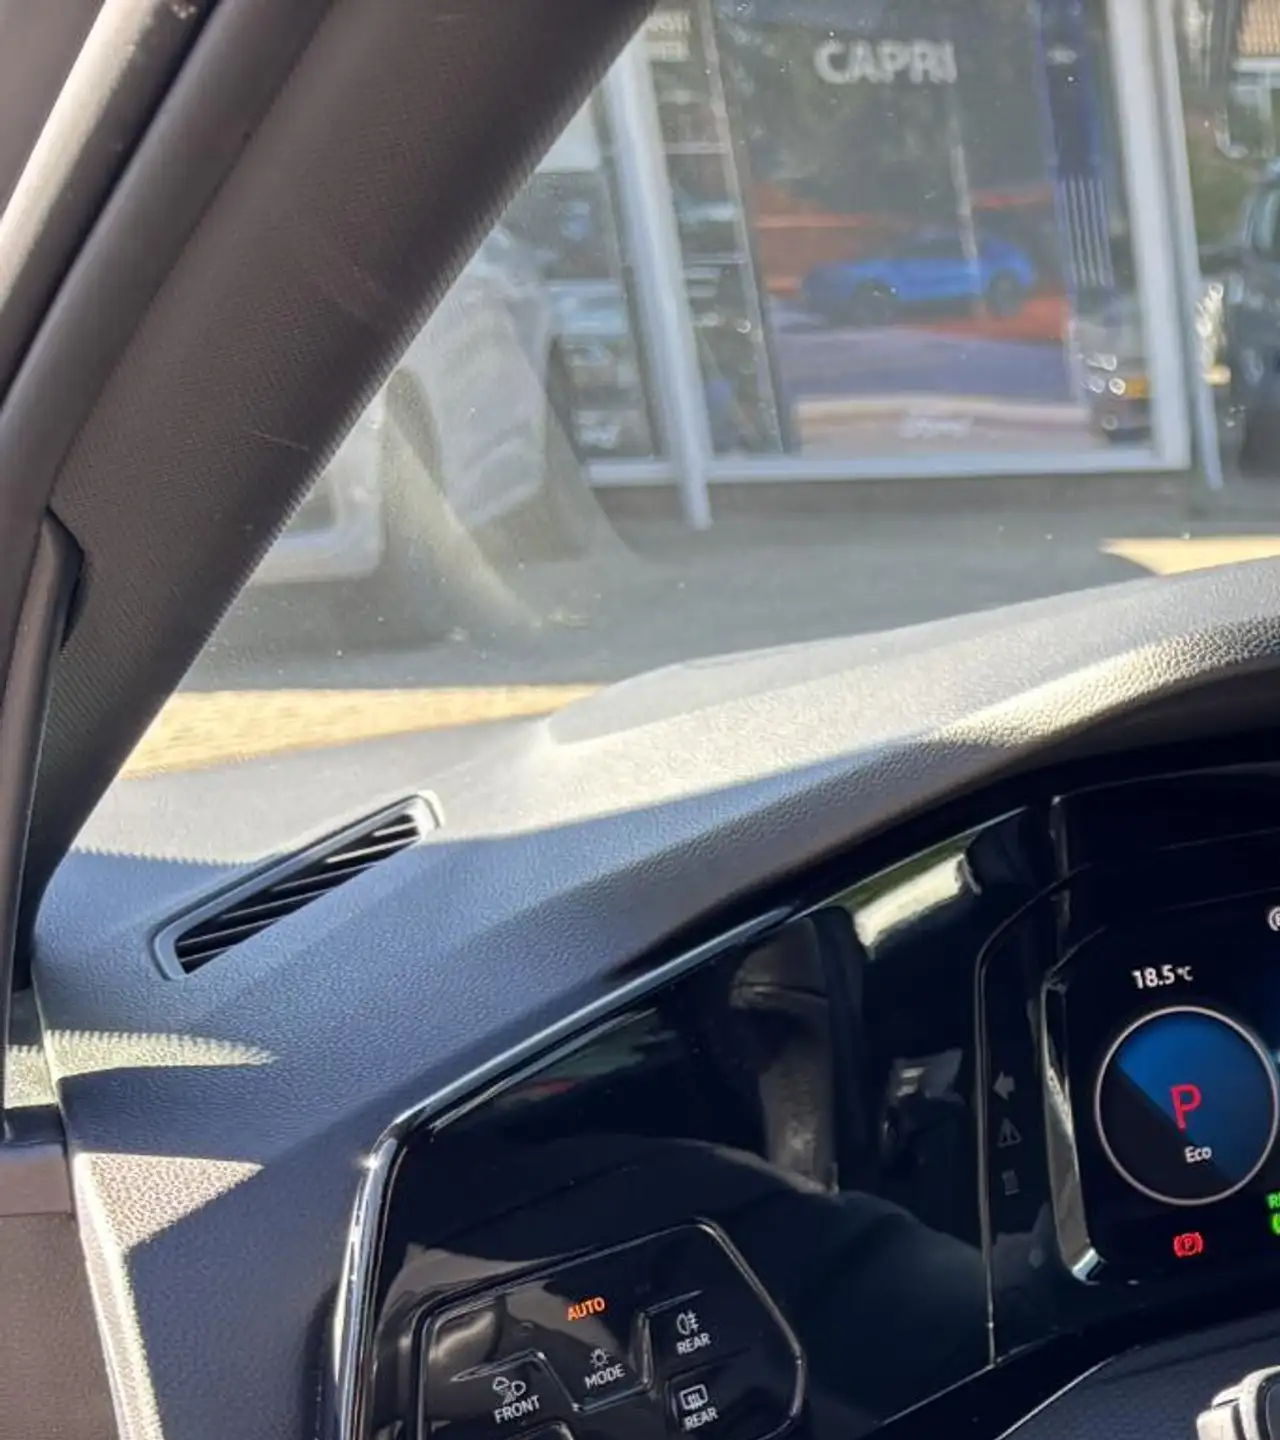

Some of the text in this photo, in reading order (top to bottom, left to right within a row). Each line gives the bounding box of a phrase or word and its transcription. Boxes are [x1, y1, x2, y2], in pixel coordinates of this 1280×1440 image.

[813, 38, 957, 84] CAPRI
[1171, 1084, 1202, 1132] P
[1184, 1146, 1213, 1164] Eco
[566, 1297, 606, 1322] AUTO
[676, 1332, 711, 1355] REAR
[584, 1363, 626, 1390] MODE
[493, 1395, 541, 1424] FRONT
[684, 1406, 719, 1432] REAR
